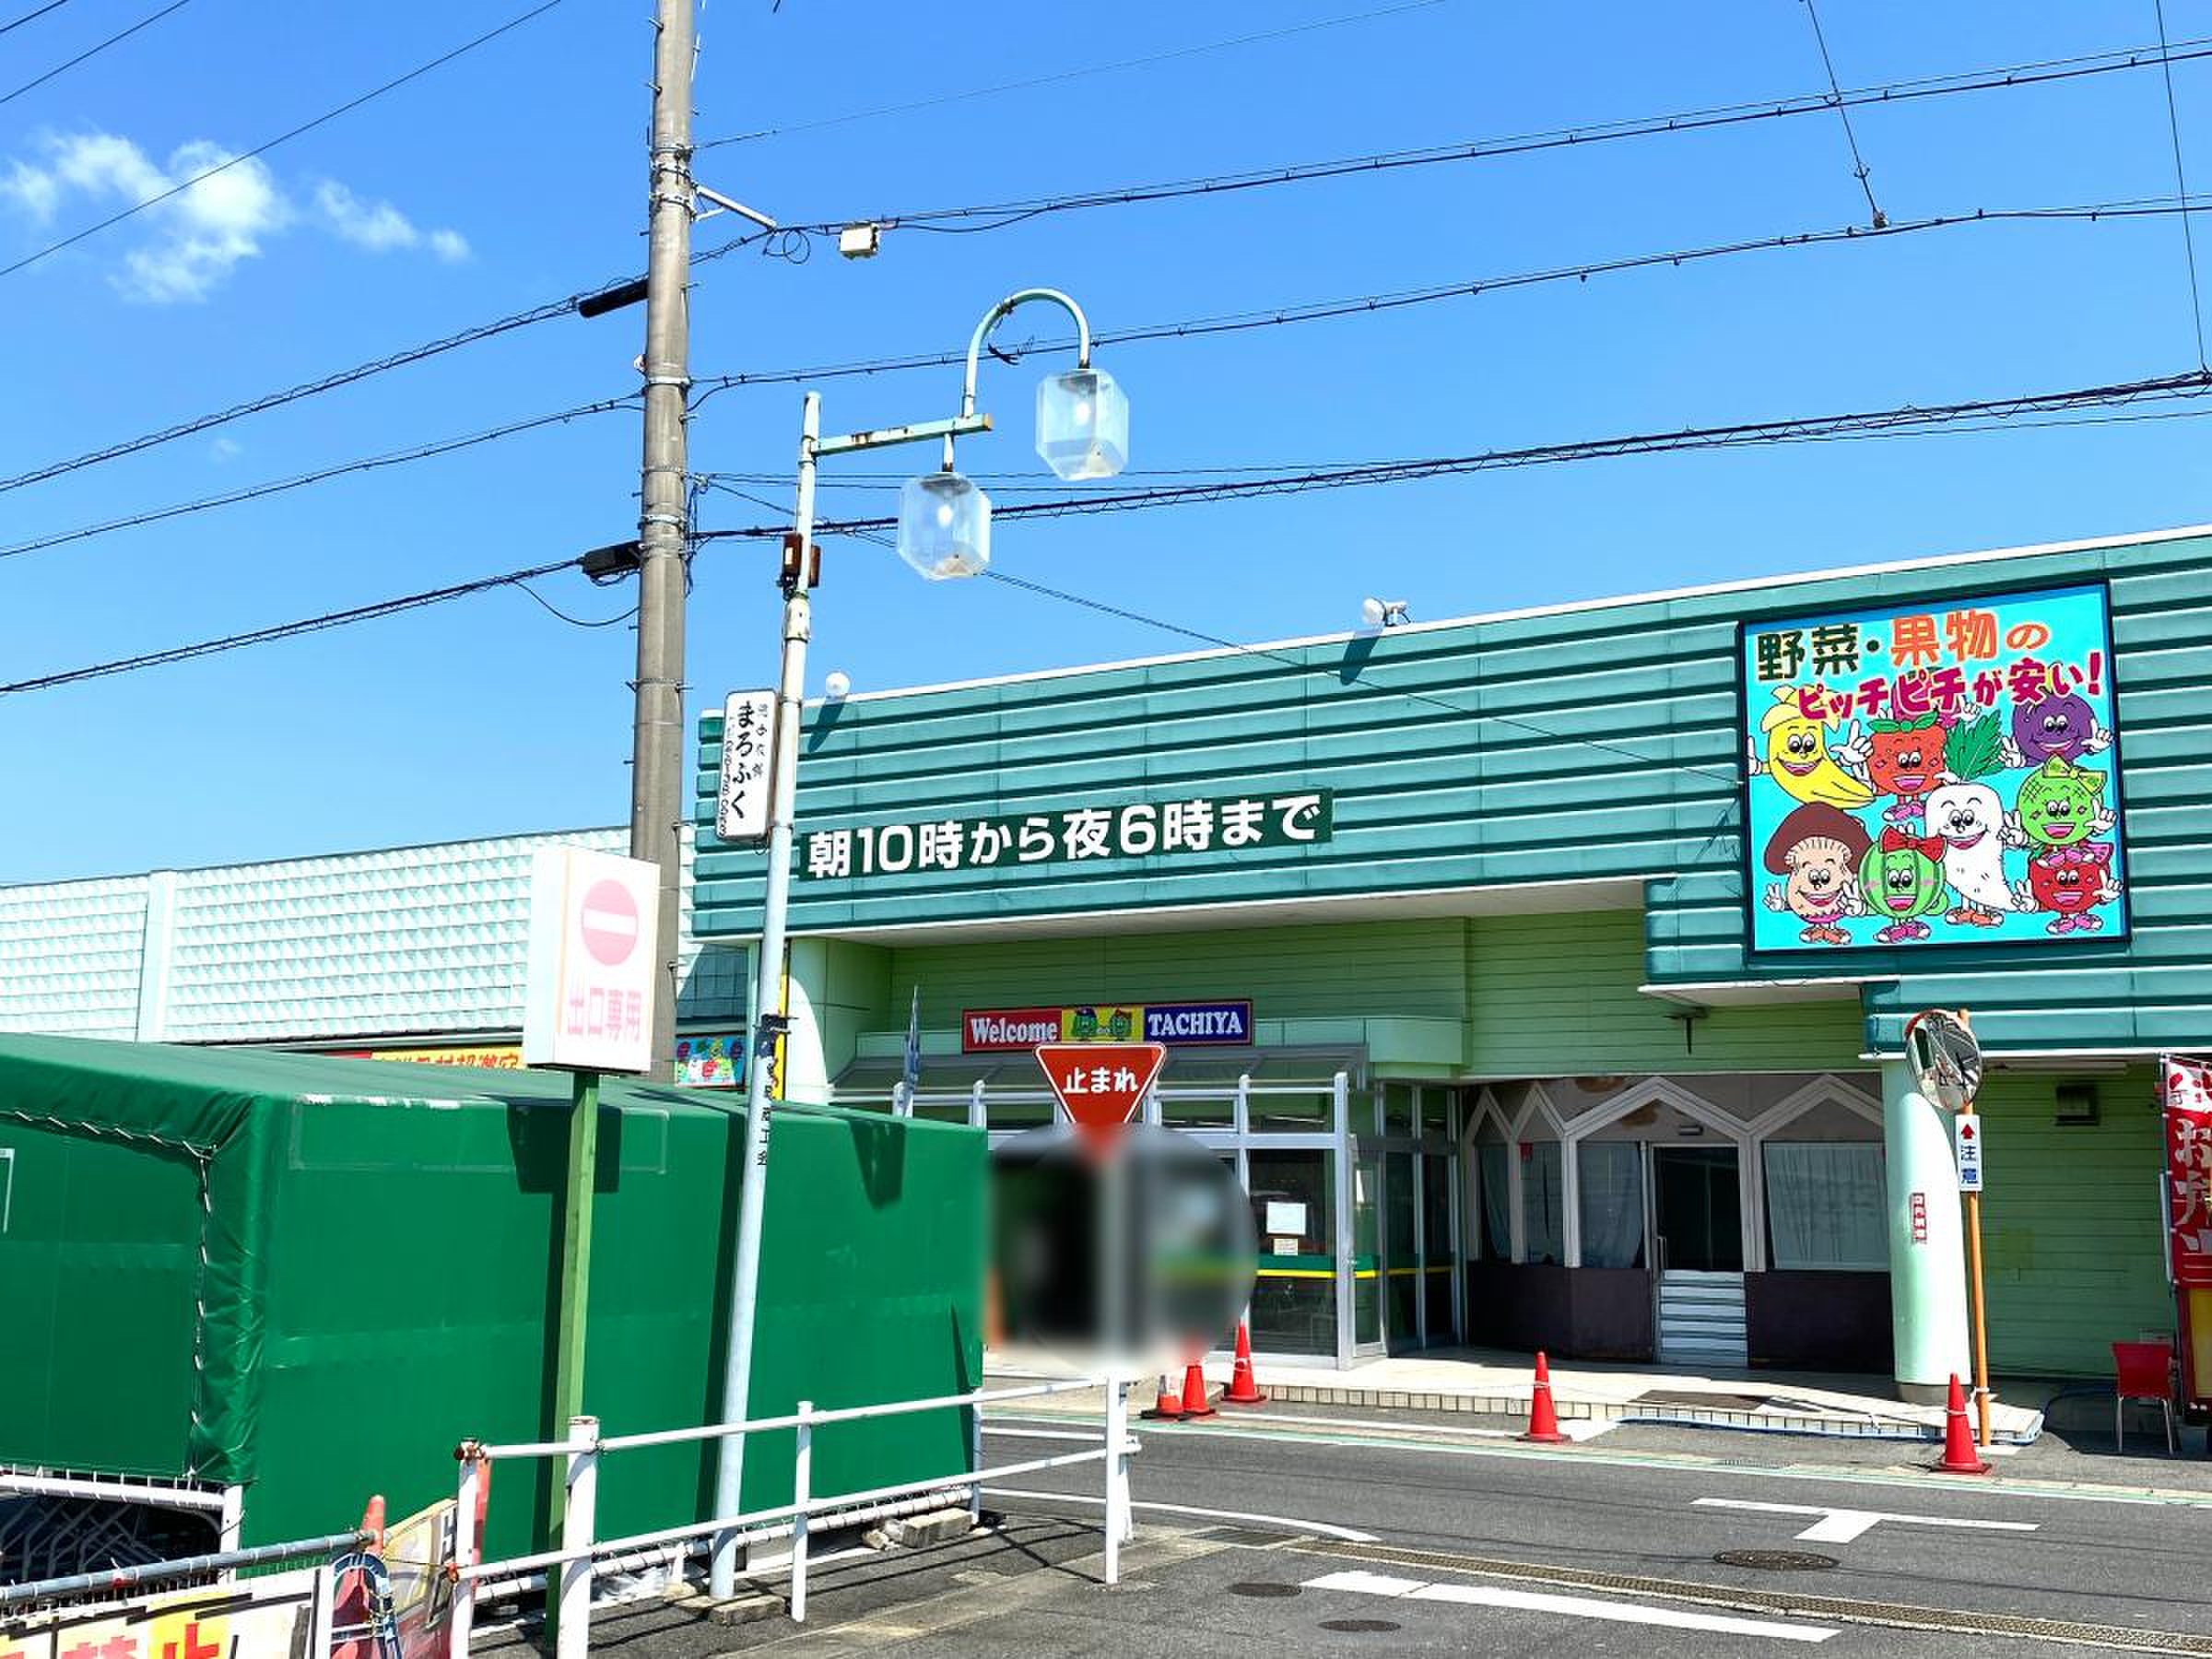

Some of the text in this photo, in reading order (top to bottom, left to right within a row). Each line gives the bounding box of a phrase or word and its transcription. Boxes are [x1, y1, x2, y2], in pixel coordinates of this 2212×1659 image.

[1757, 609, 2050, 682] 野菜・果物の
[731, 700, 756, 819] まろふく
[807, 794, 1322, 878] 朝10時から夜6時まで
[971, 1010, 1243, 1044] Welcome TACHIYA
[1063, 1066, 1138, 1094] 止まれ
[1960, 1145, 1980, 1184] 注意
